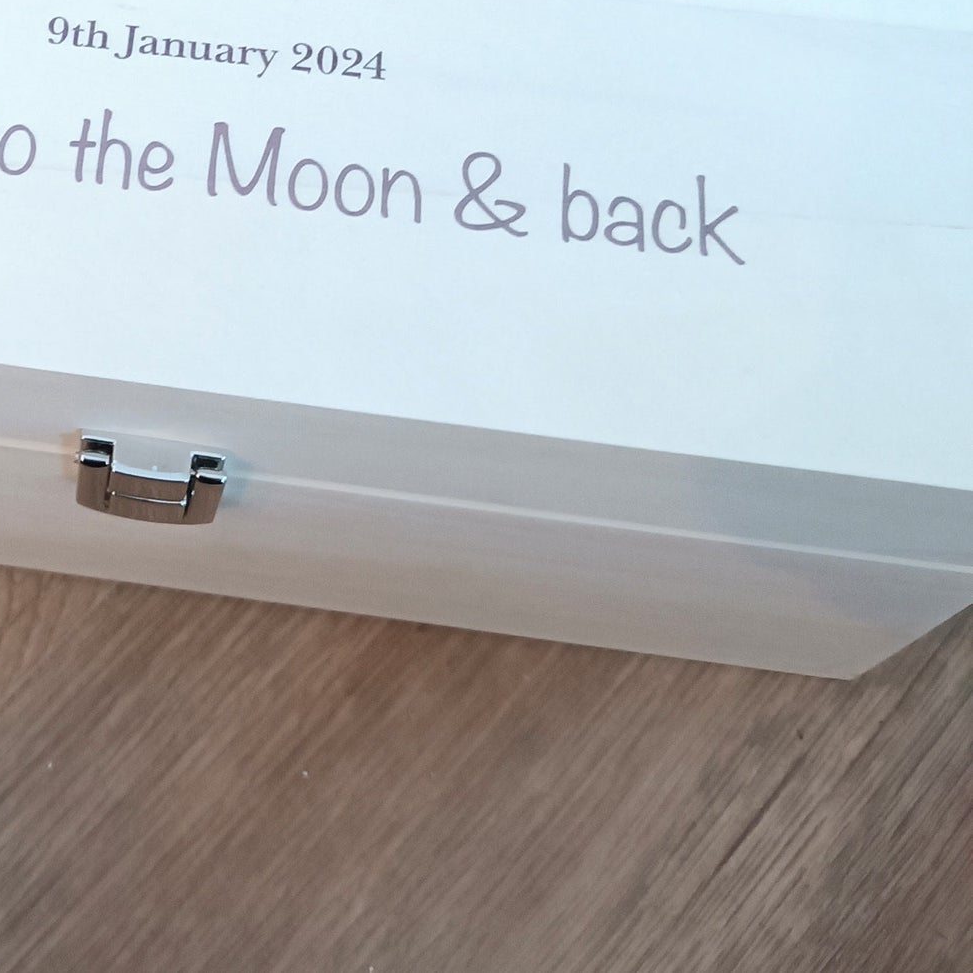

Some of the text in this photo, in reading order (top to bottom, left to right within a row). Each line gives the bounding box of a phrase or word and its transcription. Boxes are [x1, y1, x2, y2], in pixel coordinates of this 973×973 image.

[47, 15, 387, 81] 9th January 2024
[69, 108, 175, 192] the
[206, 121, 422, 224] Moon
[453, 151, 529, 238] &
[561, 162, 746, 266] back
